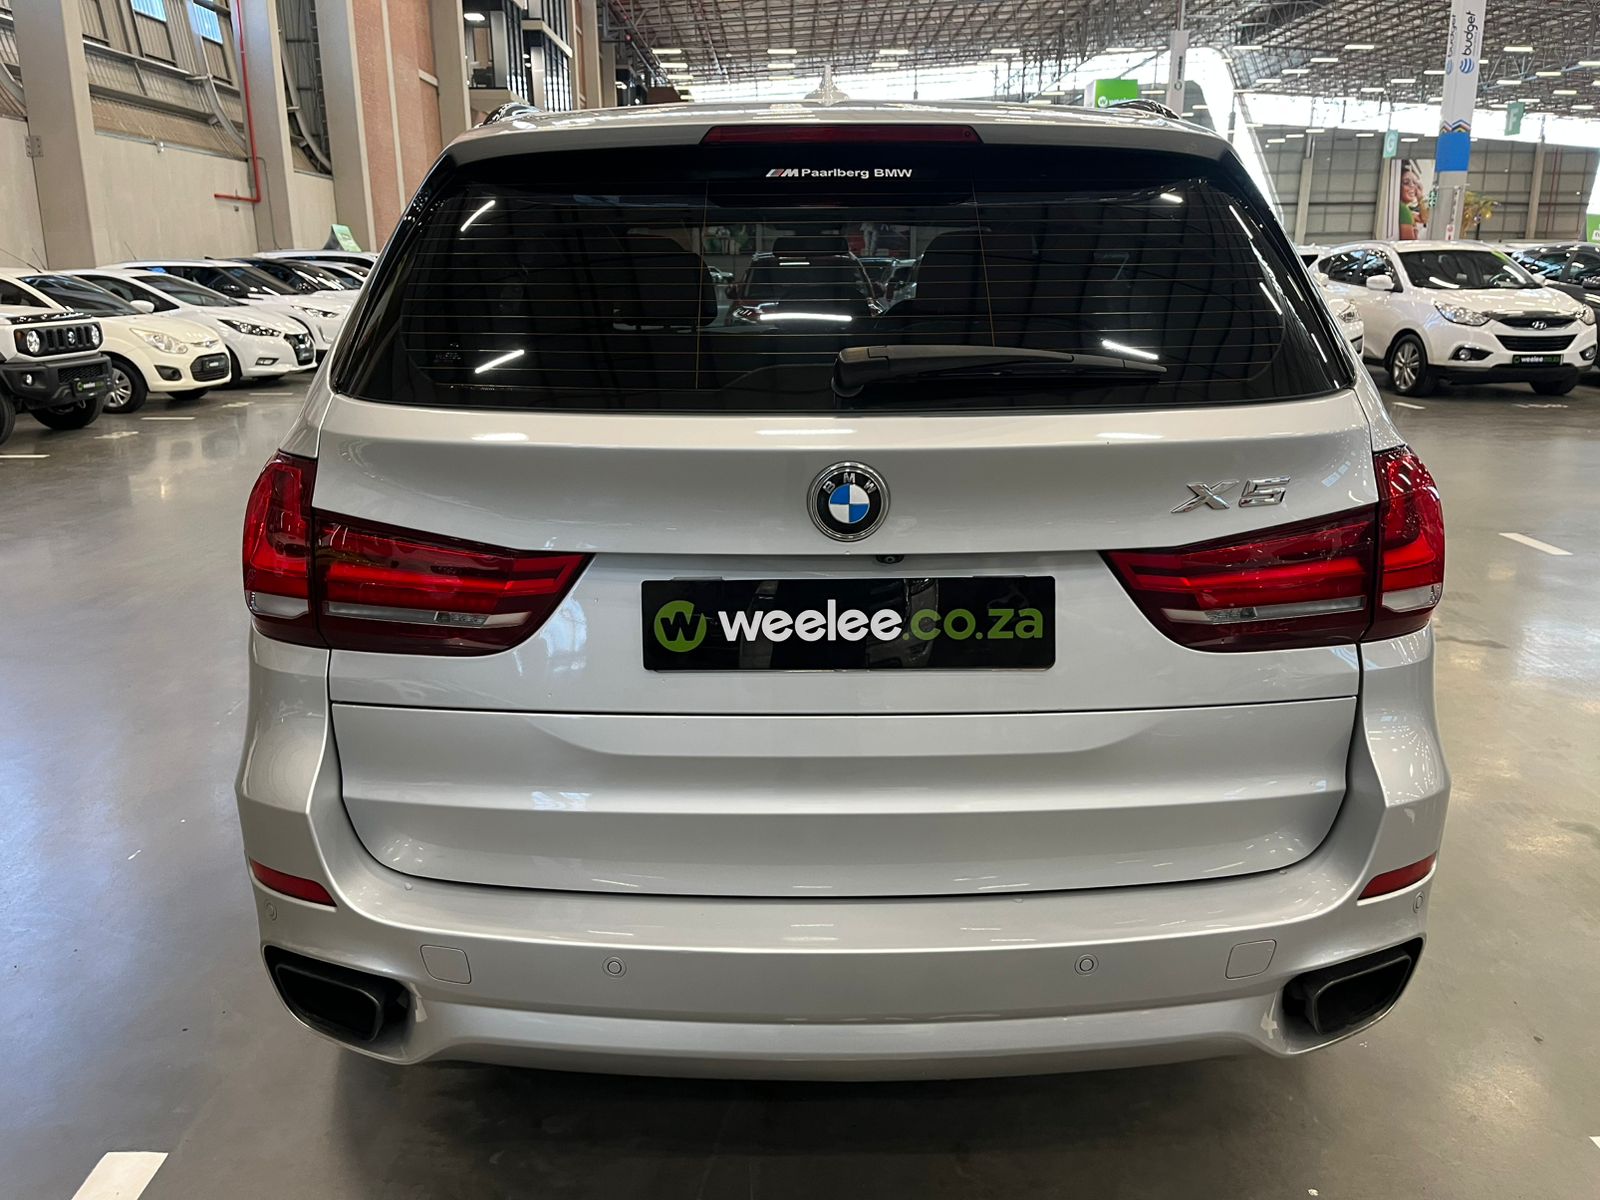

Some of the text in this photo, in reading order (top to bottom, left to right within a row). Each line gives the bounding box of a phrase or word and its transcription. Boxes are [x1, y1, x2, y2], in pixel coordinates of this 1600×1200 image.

[1461, 10, 1478, 56] budget
[801, 168, 870, 180] Paarlberg
[873, 168, 913, 178] BMW
[822, 472, 877, 495] BMW
[1170, 476, 1291, 513] X5
[718, 599, 1043, 642] weelee.co.za
